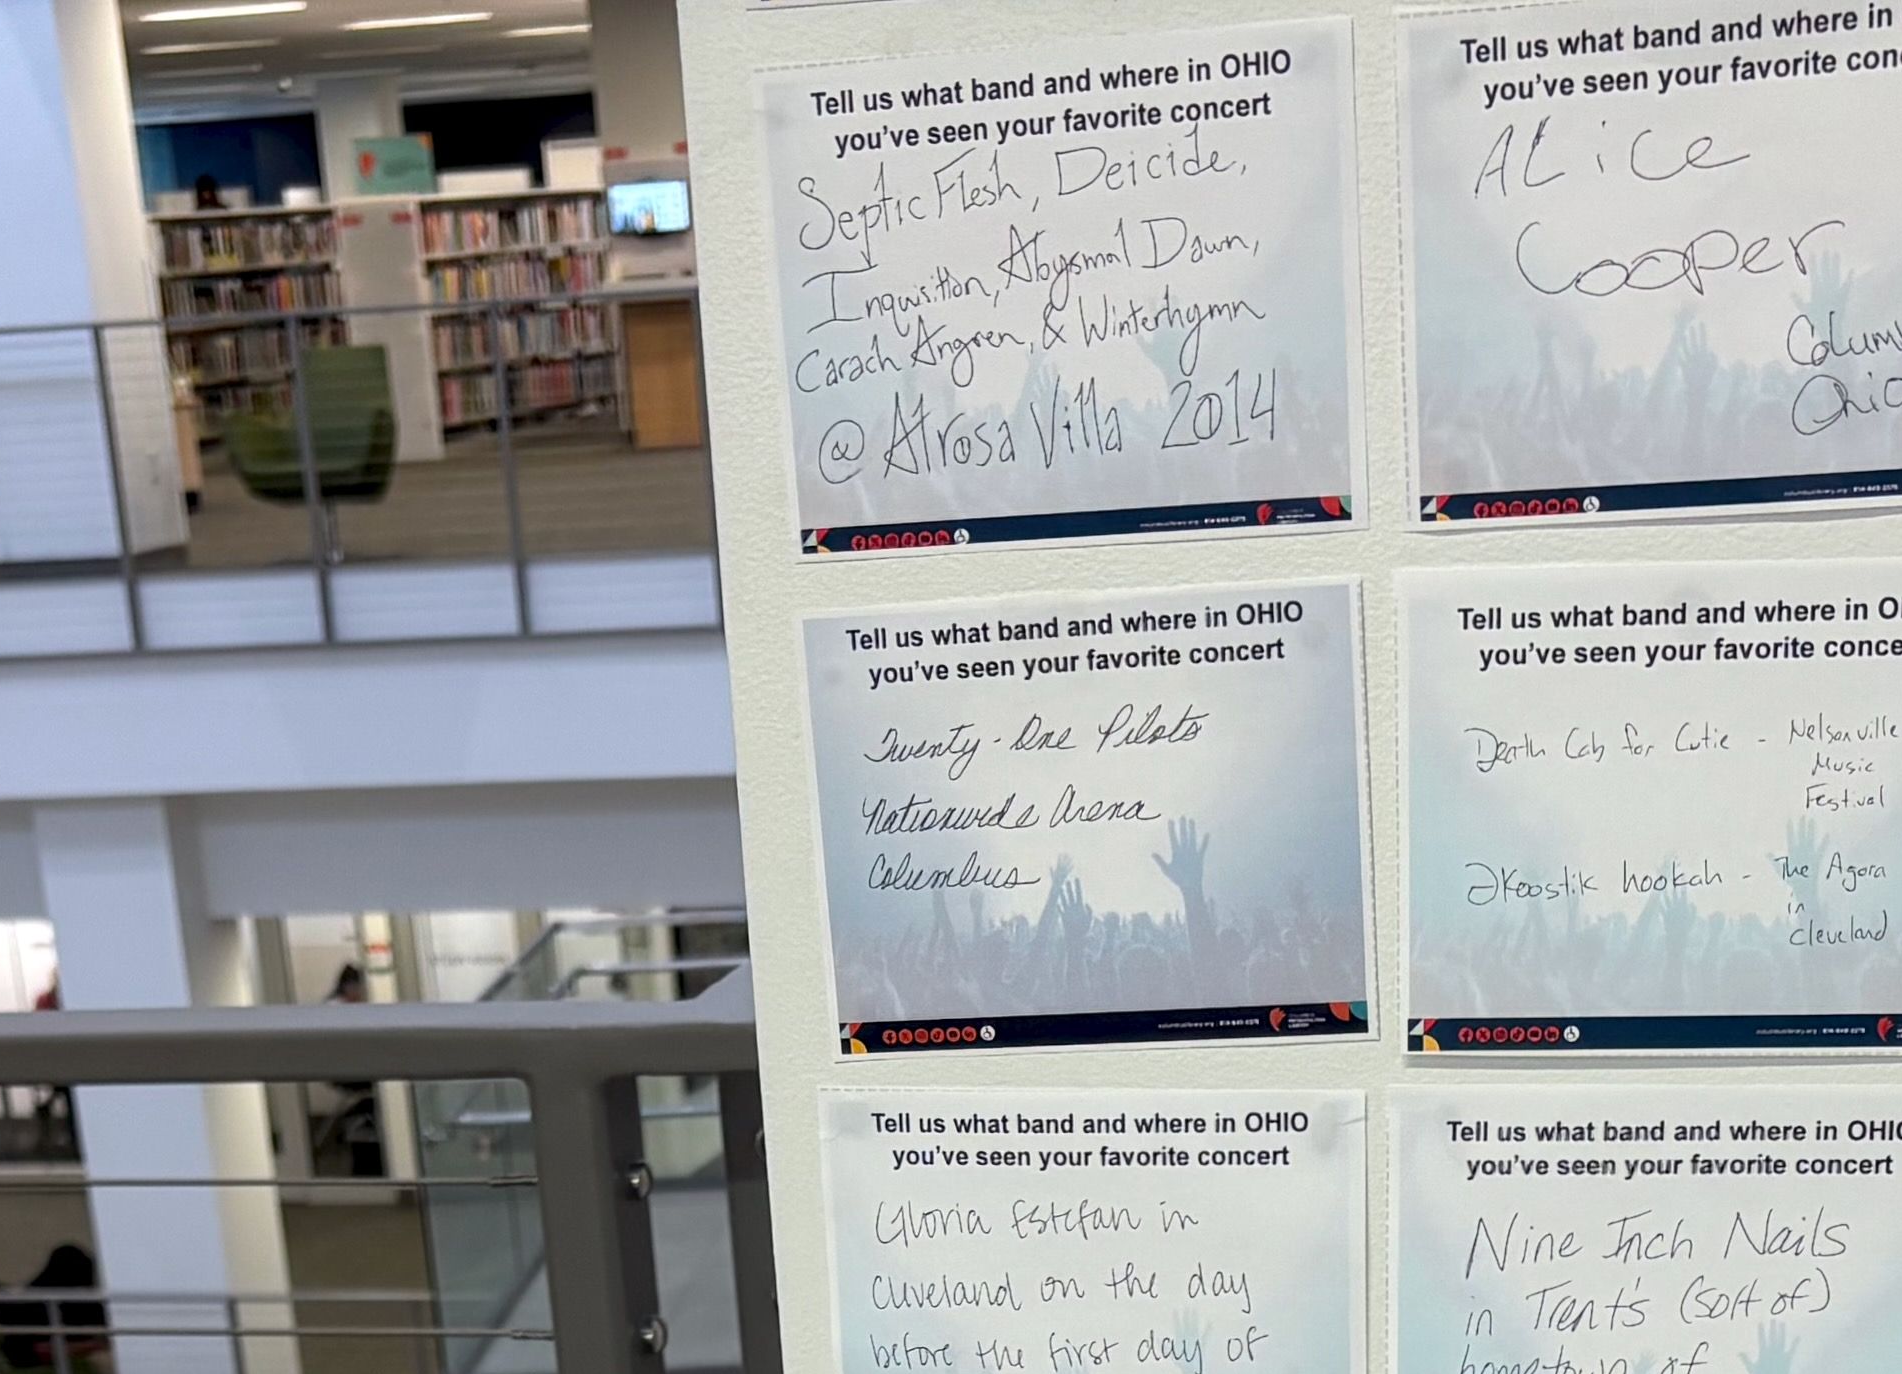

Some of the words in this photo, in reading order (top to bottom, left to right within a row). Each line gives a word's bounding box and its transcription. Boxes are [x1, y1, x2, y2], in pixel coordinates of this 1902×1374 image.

[1516, 220, 1846, 296] Cooper
[1465, 1213, 1583, 1280] Nine
[1605, 1210, 1693, 1260] Inch
[1723, 1207, 1849, 1259] Nails
